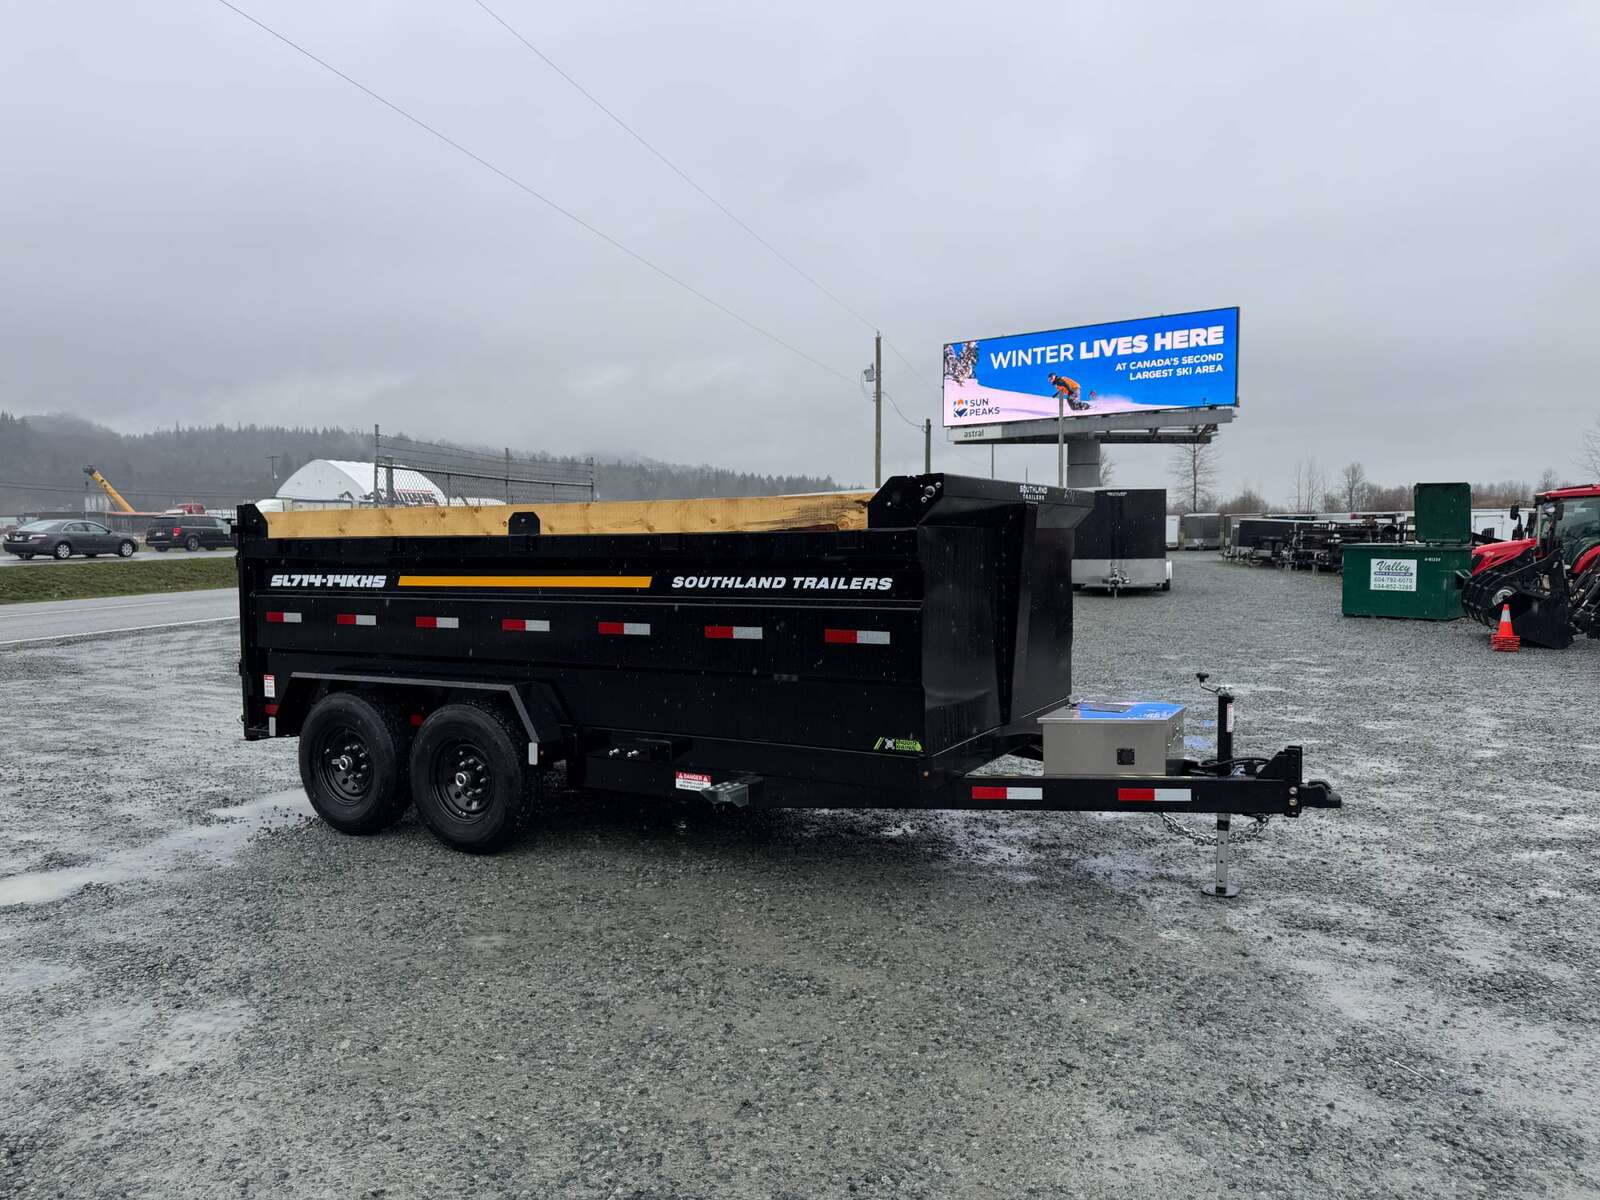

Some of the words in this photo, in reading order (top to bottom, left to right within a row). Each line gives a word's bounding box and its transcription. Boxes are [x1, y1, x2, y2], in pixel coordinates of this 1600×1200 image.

[990, 343, 1074, 370] WINTER
[1080, 335, 1149, 360] LIVES
[1153, 325, 1224, 352] HERE
[1115, 362, 1127, 371] AT
[1129, 357, 1179, 370] CANADA'S
[1181, 352, 1224, 365] SECOND
[1129, 368, 1173, 381] LARGEST
[1176, 367, 1192, 376] SKI
[1194, 364, 1223, 375] AREA
[969, 398, 989, 407] SUN
[969, 406, 1000, 416] PEAKS
[963, 429, 985, 438] astral
[1376, 560, 1411, 572] Valley
[270, 574, 387, 588] SL714-14KHS
[671, 576, 786, 589] SOUTHLAND
[792, 577, 893, 591] TRAILERS
